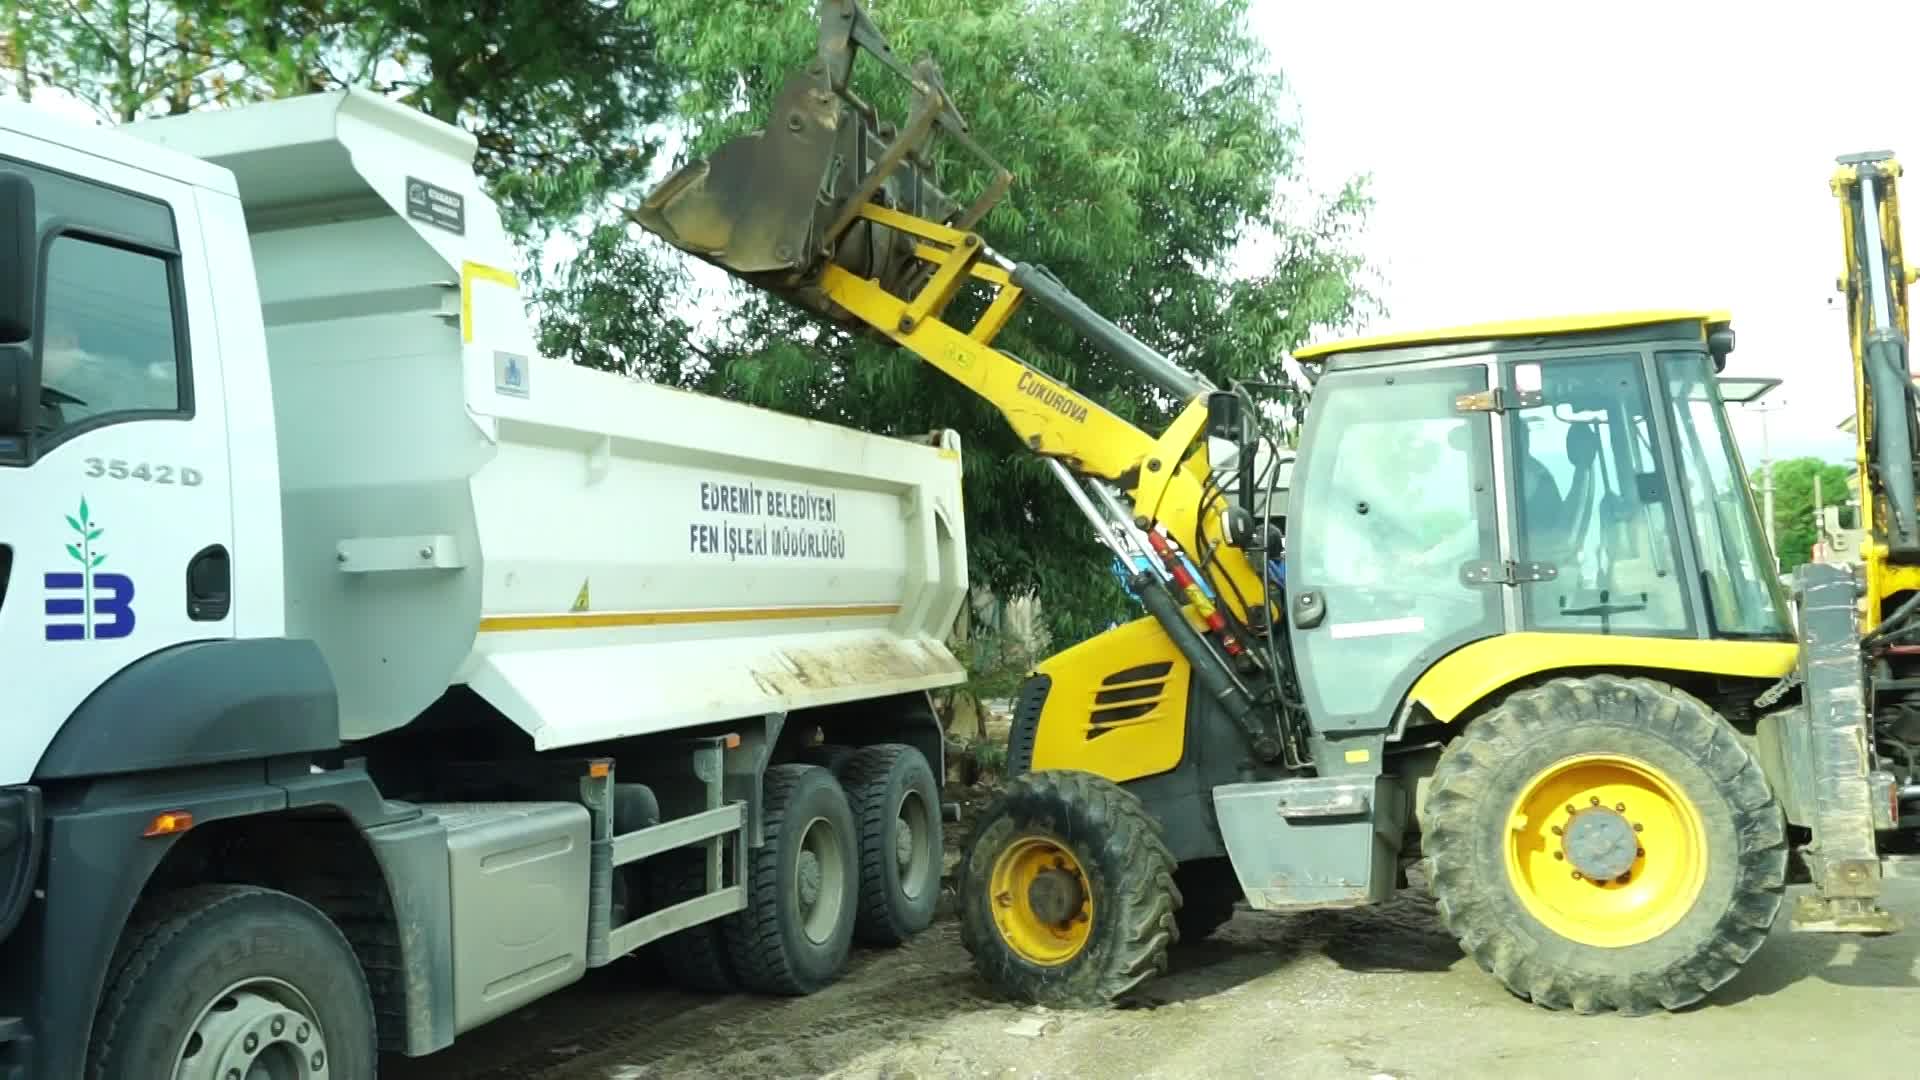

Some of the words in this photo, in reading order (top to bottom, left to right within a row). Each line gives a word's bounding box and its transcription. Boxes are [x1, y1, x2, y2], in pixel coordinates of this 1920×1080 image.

[701, 482, 763, 515] EDREMİT
[767, 489, 836, 522] BELEDİYESİ
[690, 524, 719, 553] FEN
